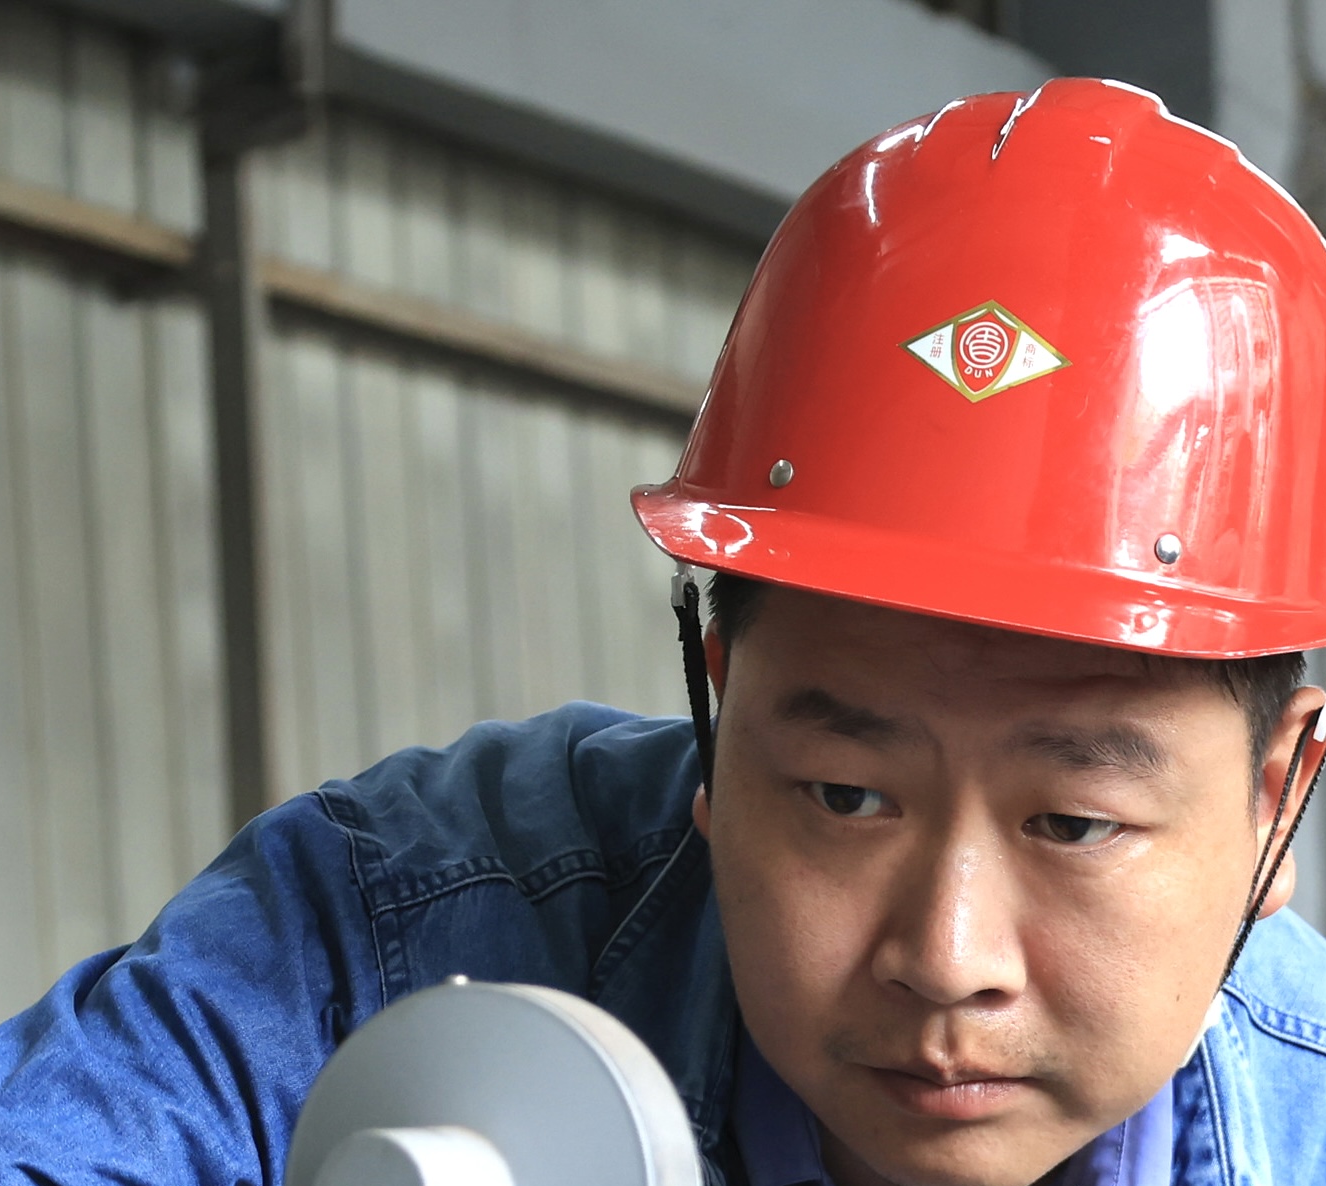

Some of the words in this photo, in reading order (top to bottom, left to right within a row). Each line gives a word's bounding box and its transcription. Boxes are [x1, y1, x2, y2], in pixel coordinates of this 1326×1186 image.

[929, 333, 945, 359] 注册
[1022, 343, 1037, 369] 商标
[963, 365, 994, 379] DUN
